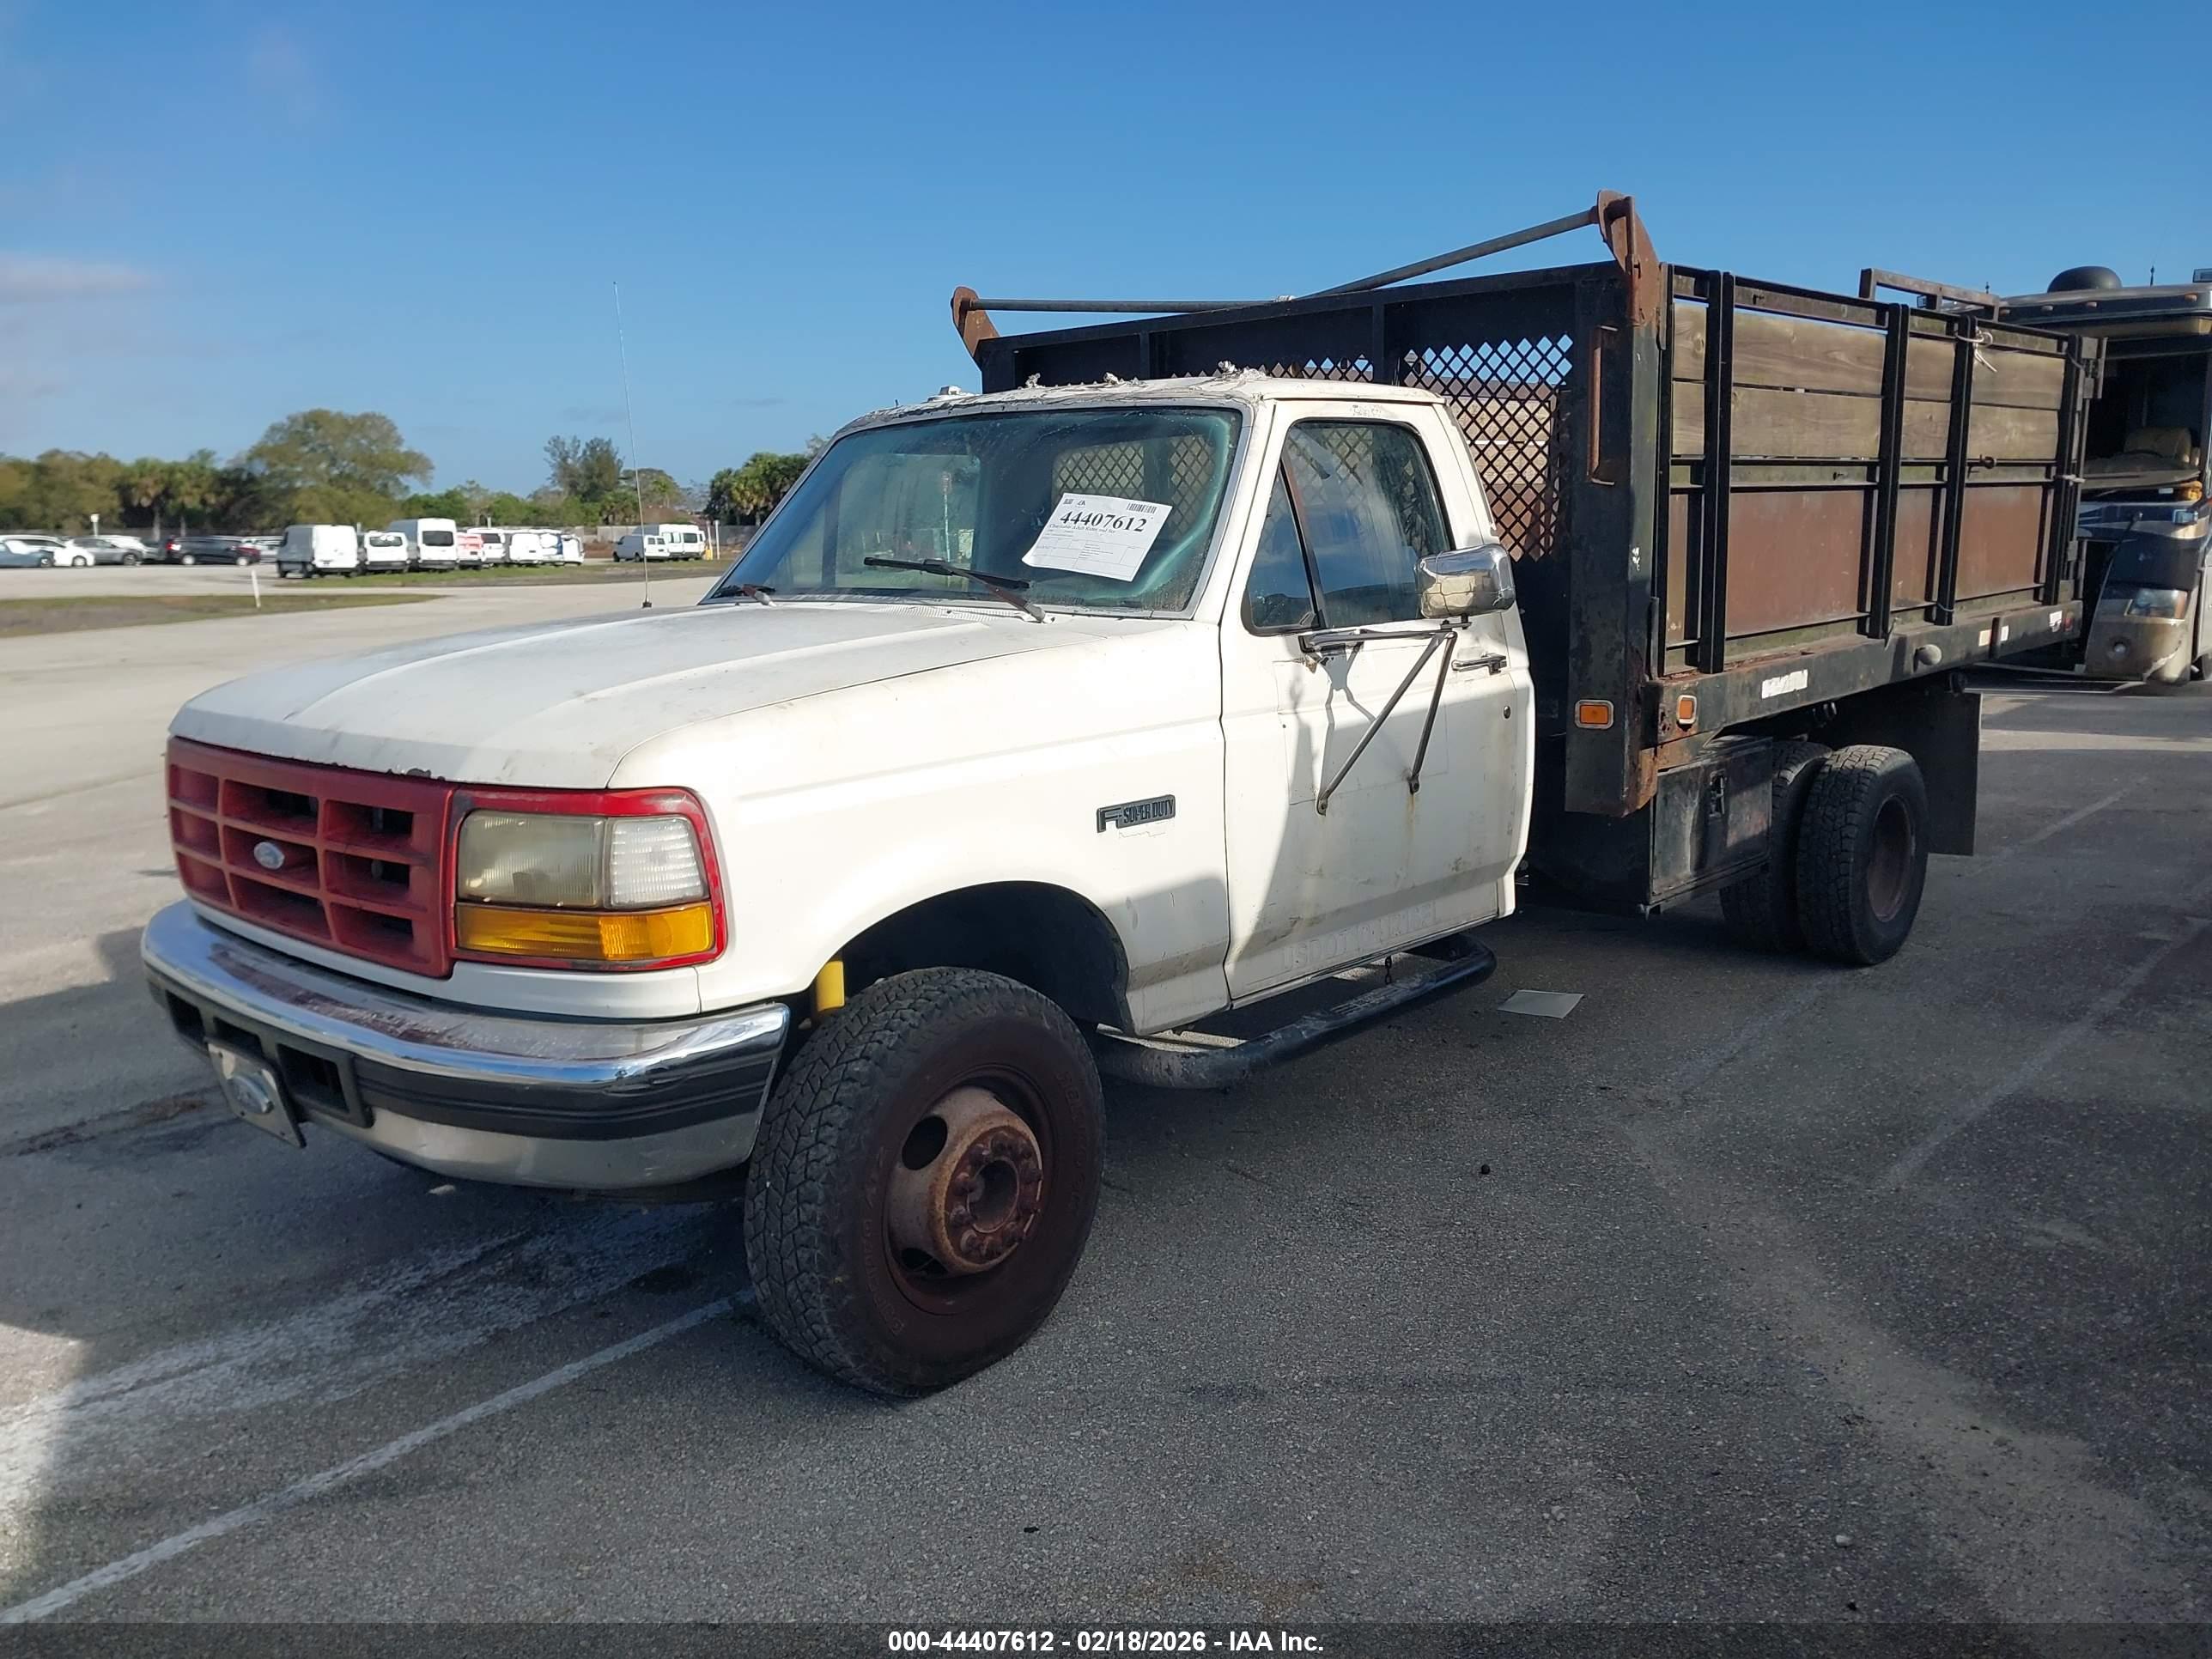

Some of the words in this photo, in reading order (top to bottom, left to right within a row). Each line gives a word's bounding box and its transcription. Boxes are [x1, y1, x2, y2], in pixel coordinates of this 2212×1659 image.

[1060, 511, 1147, 532] 44407612
[1123, 804, 1151, 823] SUPER
[1152, 799, 1175, 818] DUTY
